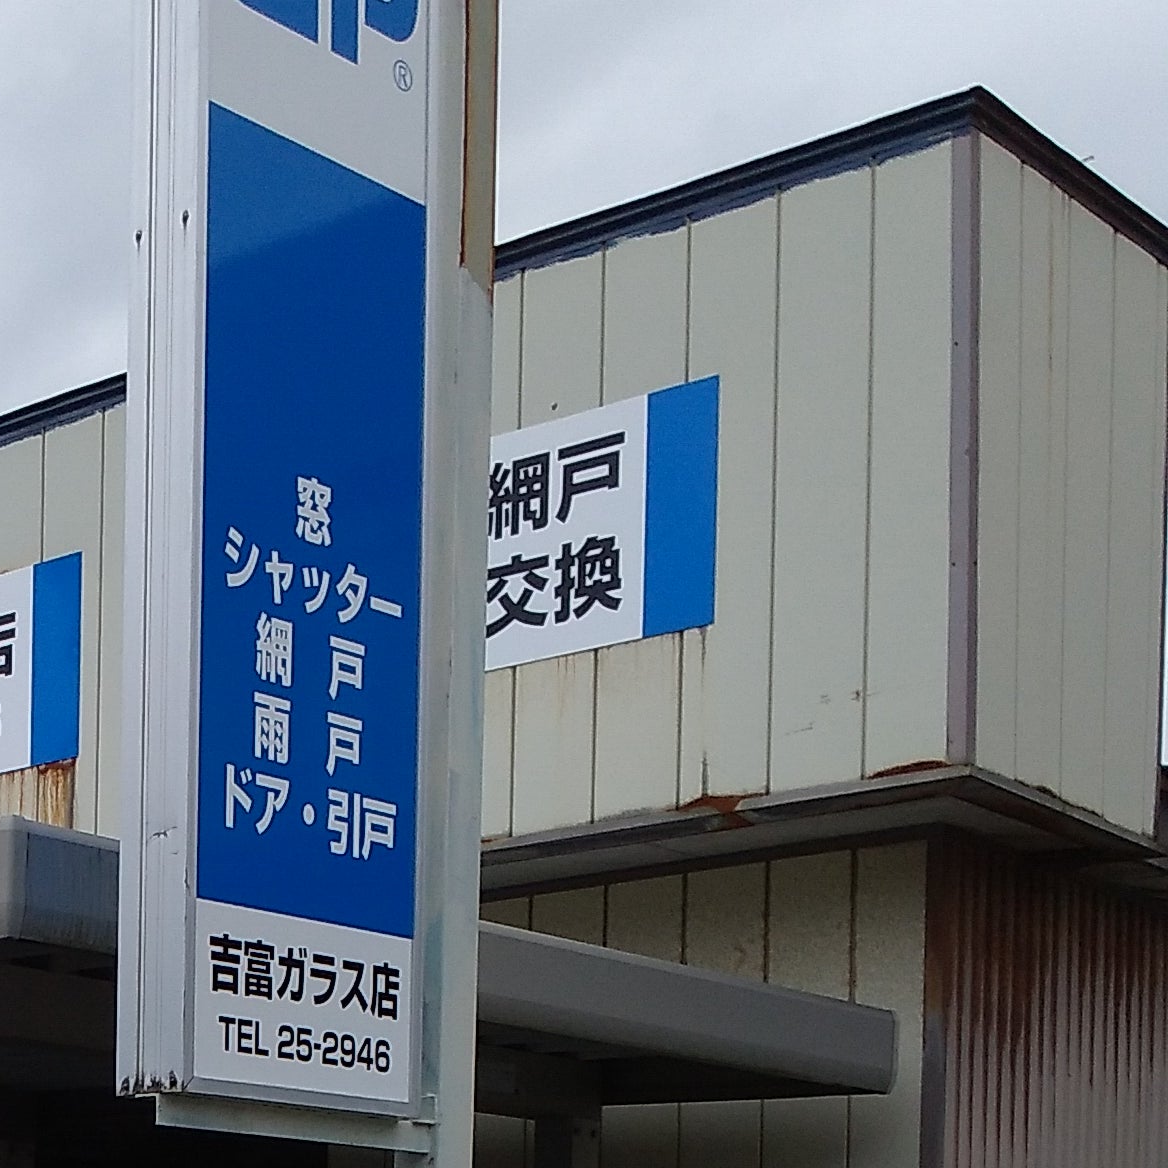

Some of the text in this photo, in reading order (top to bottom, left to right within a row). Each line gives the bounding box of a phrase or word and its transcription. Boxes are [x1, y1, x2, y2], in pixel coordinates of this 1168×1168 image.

[296, 475, 332, 547] 窓
[488, 430, 626, 541] 網戸
[224, 526, 404, 624] シャッター
[485, 534, 623, 639] 交換
[224, 762, 398, 861] ドア・引戸
[208, 933, 401, 1021] 吉富ガラス店
[217, 1015, 391, 1075] TEL 25-2946
